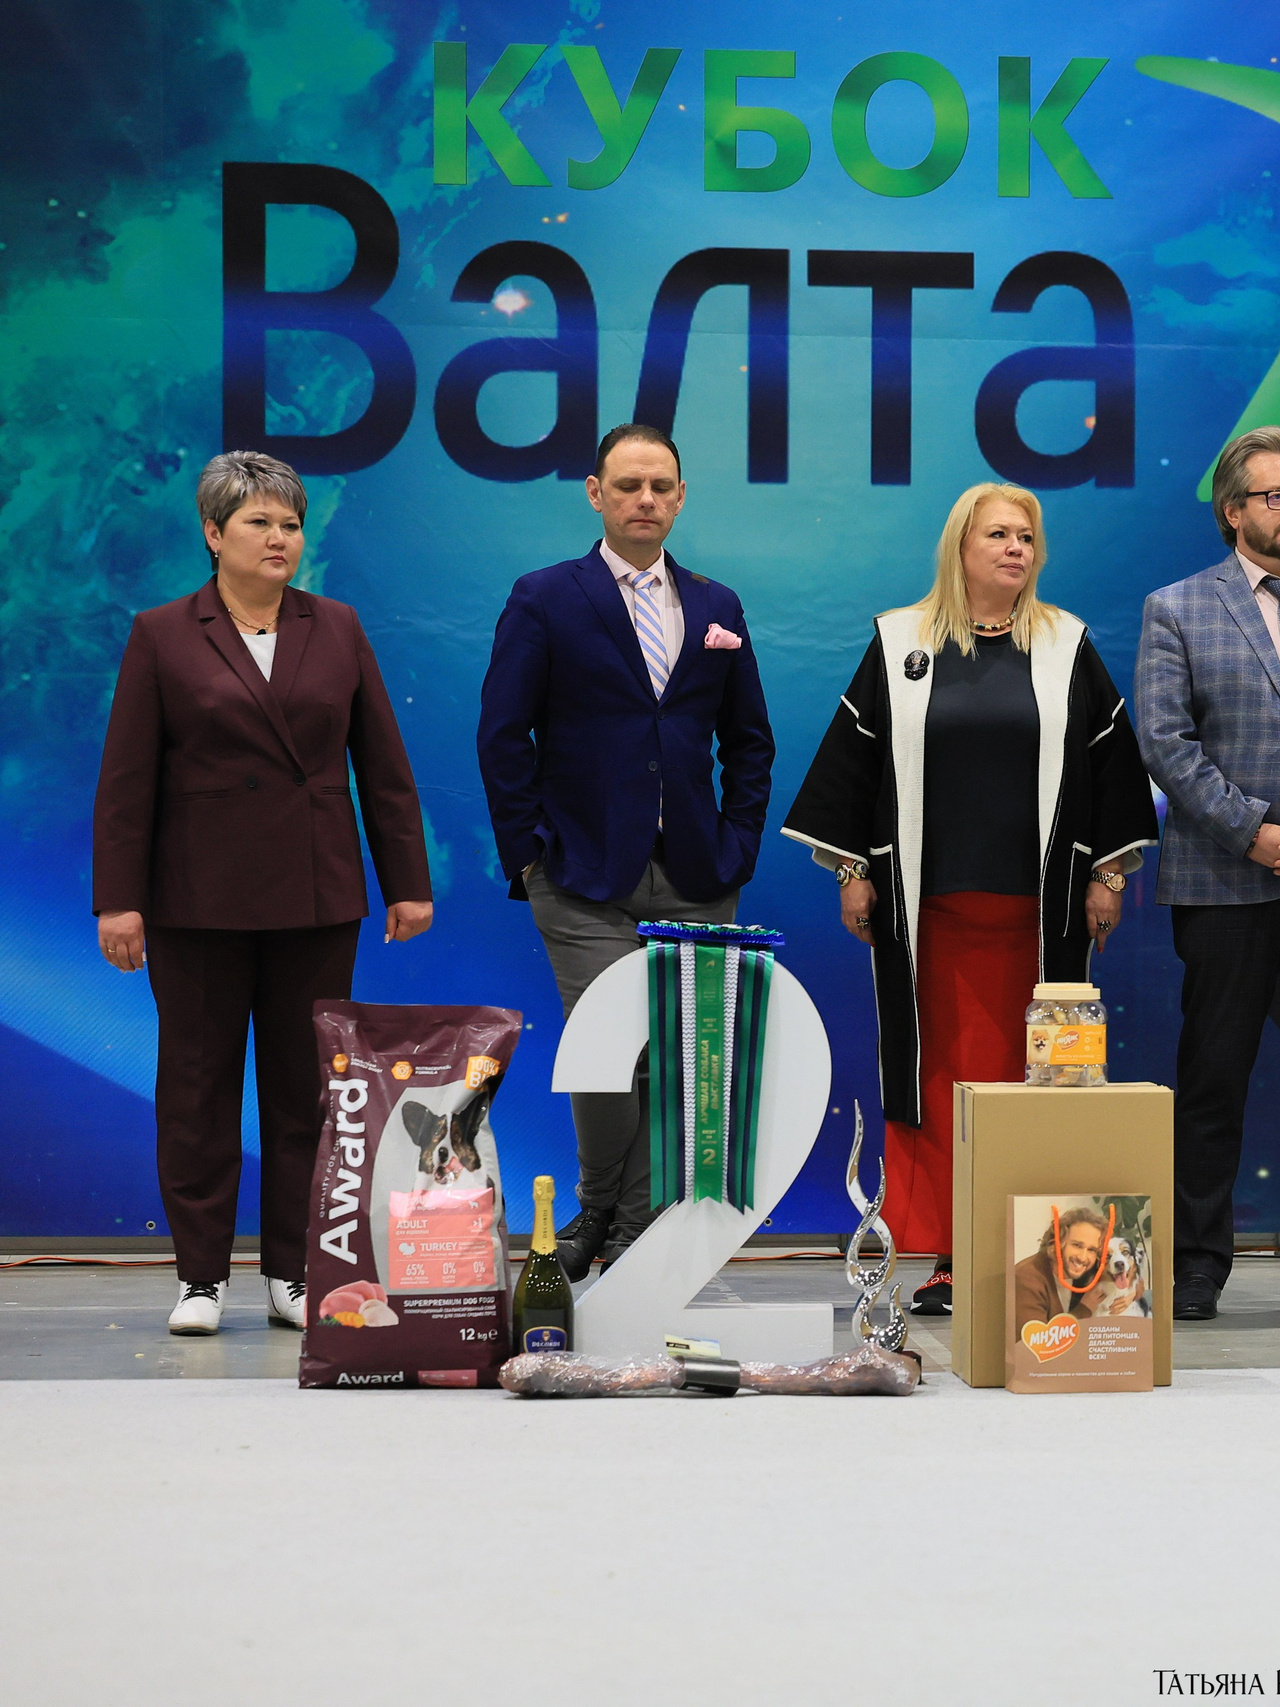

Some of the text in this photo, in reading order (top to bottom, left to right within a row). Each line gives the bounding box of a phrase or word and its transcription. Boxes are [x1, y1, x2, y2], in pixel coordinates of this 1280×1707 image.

[433, 41, 1113, 199] КУБОК
[222, 162, 1135, 489] Валта
[701, 1039, 709, 1079] СОБАКА
[551, 945, 833, 1359] 2
[703, 1148, 716, 1165] 2
[319, 1078, 369, 1265] Award
[319, 1174, 331, 1218] QUALITY
[327, 1153, 336, 1174] FOR
[396, 1219, 428, 1229] ADULT
[420, 1242, 457, 1251] TURKEY
[406, 1261, 485, 1276] 65% 0% 0%
[403, 1299, 462, 1307] SUPERPREMIUM
[463, 1297, 478, 1305] DOG
[460, 1328, 475, 1341] 12
[477, 1332, 487, 1341] kg
[1029, 1324, 1076, 1347] МНЯМС
[336, 1371, 404, 1385] Award
